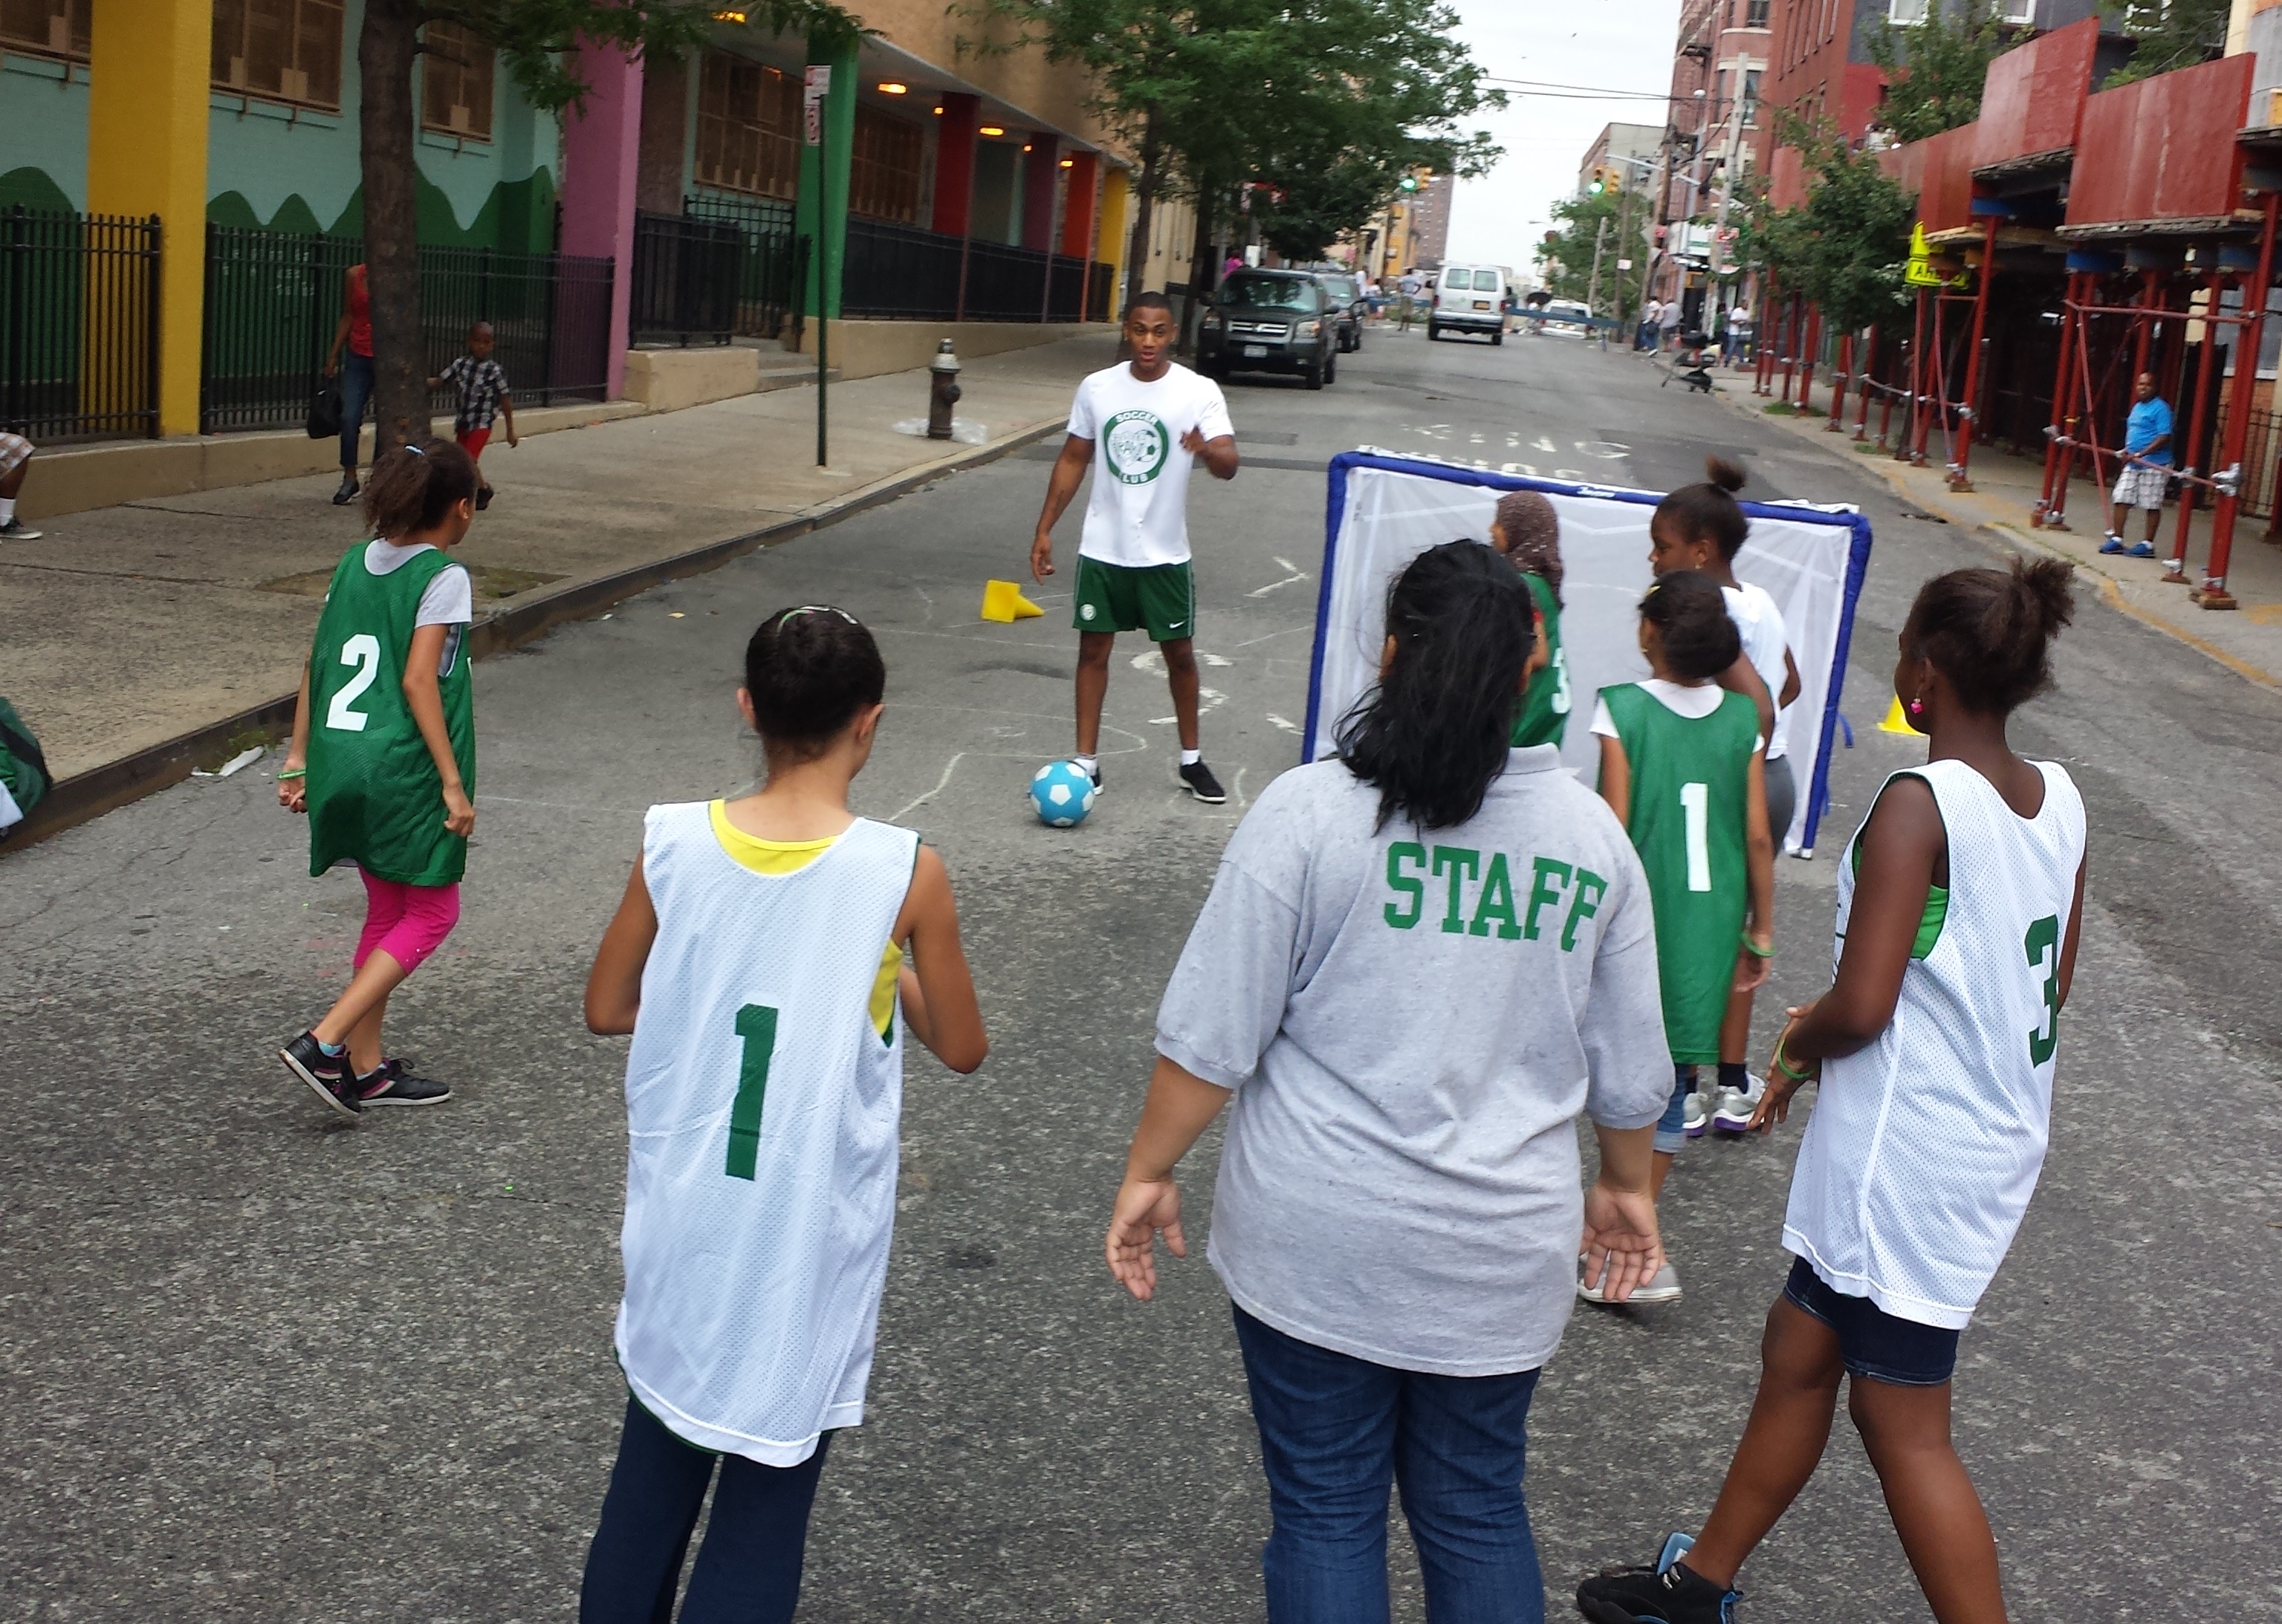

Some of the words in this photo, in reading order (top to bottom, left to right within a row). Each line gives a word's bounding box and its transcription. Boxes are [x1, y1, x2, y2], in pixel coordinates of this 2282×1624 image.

[326, 634, 380, 732] 2
[1550, 646, 1572, 715] 3
[1680, 782, 1712, 891] 1
[1384, 841, 1607, 952] STAFF
[2025, 914, 2059, 1068] 3
[726, 1003, 779, 1181] 1
